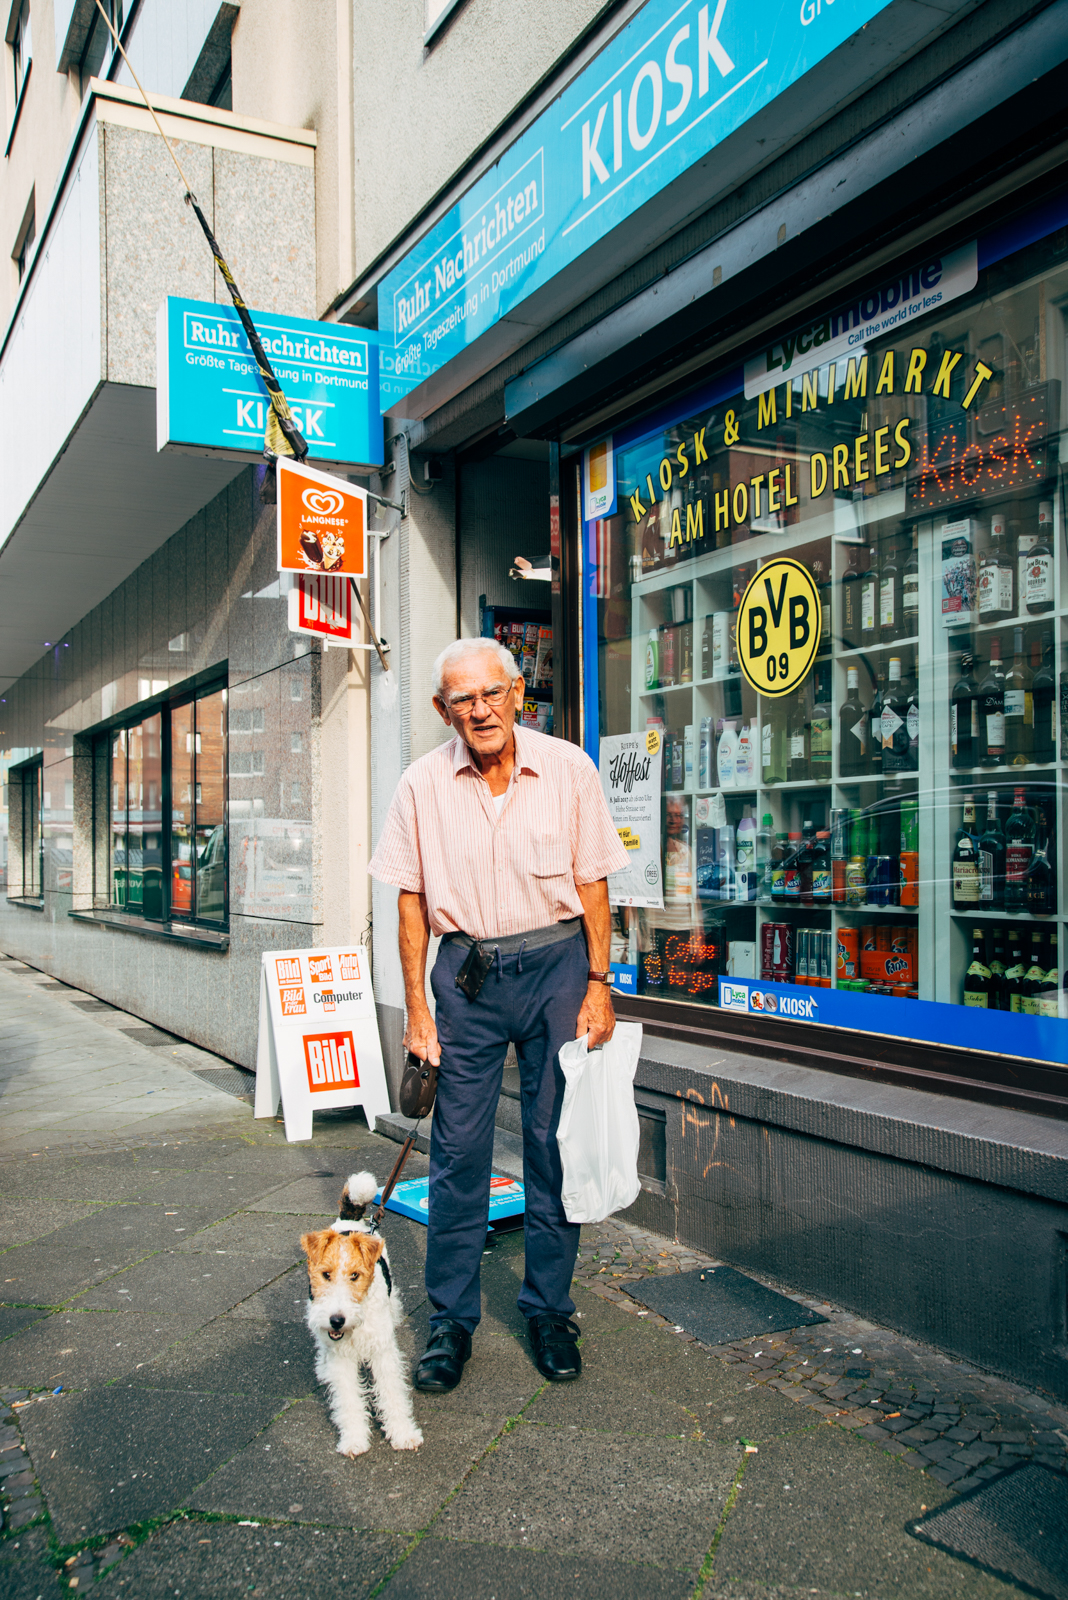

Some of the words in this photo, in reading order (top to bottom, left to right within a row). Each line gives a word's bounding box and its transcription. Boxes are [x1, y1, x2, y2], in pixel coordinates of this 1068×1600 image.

[582, 0, 735, 200] KIOSK
[398, 280, 431, 333] Ruhr
[434, 180, 538, 299] Nachrichten
[395, 343, 421, 375] Größte
[422, 291, 478, 351] Tageszeitung
[480, 283, 490, 301] in
[492, 227, 545, 290] Dortmund
[848, 329, 865, 345] Call
[866, 322, 880, 337] the
[881, 306, 907, 329] world
[908, 300, 921, 317] for
[922, 291, 943, 309] less
[191, 321, 240, 347] Ruhr
[185, 352, 225, 369] Größte
[228, 359, 299, 383] Tagesitung
[302, 371, 312, 382] in
[315, 372, 368, 390] Dortmund
[237, 398, 324, 437] KISK
[629, 427, 709, 524] KIOSK
[723, 409, 740, 447] &
[757, 347, 994, 431] MINIMARKT
[669, 499, 704, 549] AM
[714, 463, 798, 532] HOTEL
[810, 418, 911, 499] DREES
[749, 572, 810, 659] BVB
[767, 652, 789, 682] 09
[524, 702, 538, 712] tv
[277, 959, 300, 979] Bild
[309, 956, 331, 976] Sport
[340, 954, 358, 967] Auto
[885, 958, 908, 975] Fanta
[319, 972, 332, 981] Bild
[342, 967, 358, 980] Bild
[619, 973, 632, 985] KIOSK
[282, 989, 303, 1002] Bild
[313, 991, 363, 1004] Computer
[732, 988, 746, 999] Lyca
[283, 1002, 305, 1014] Frau
[324, 1003, 335, 1011] Bild
[780, 996, 814, 1018] KIOSK
[308, 1037, 355, 1084] Bild
